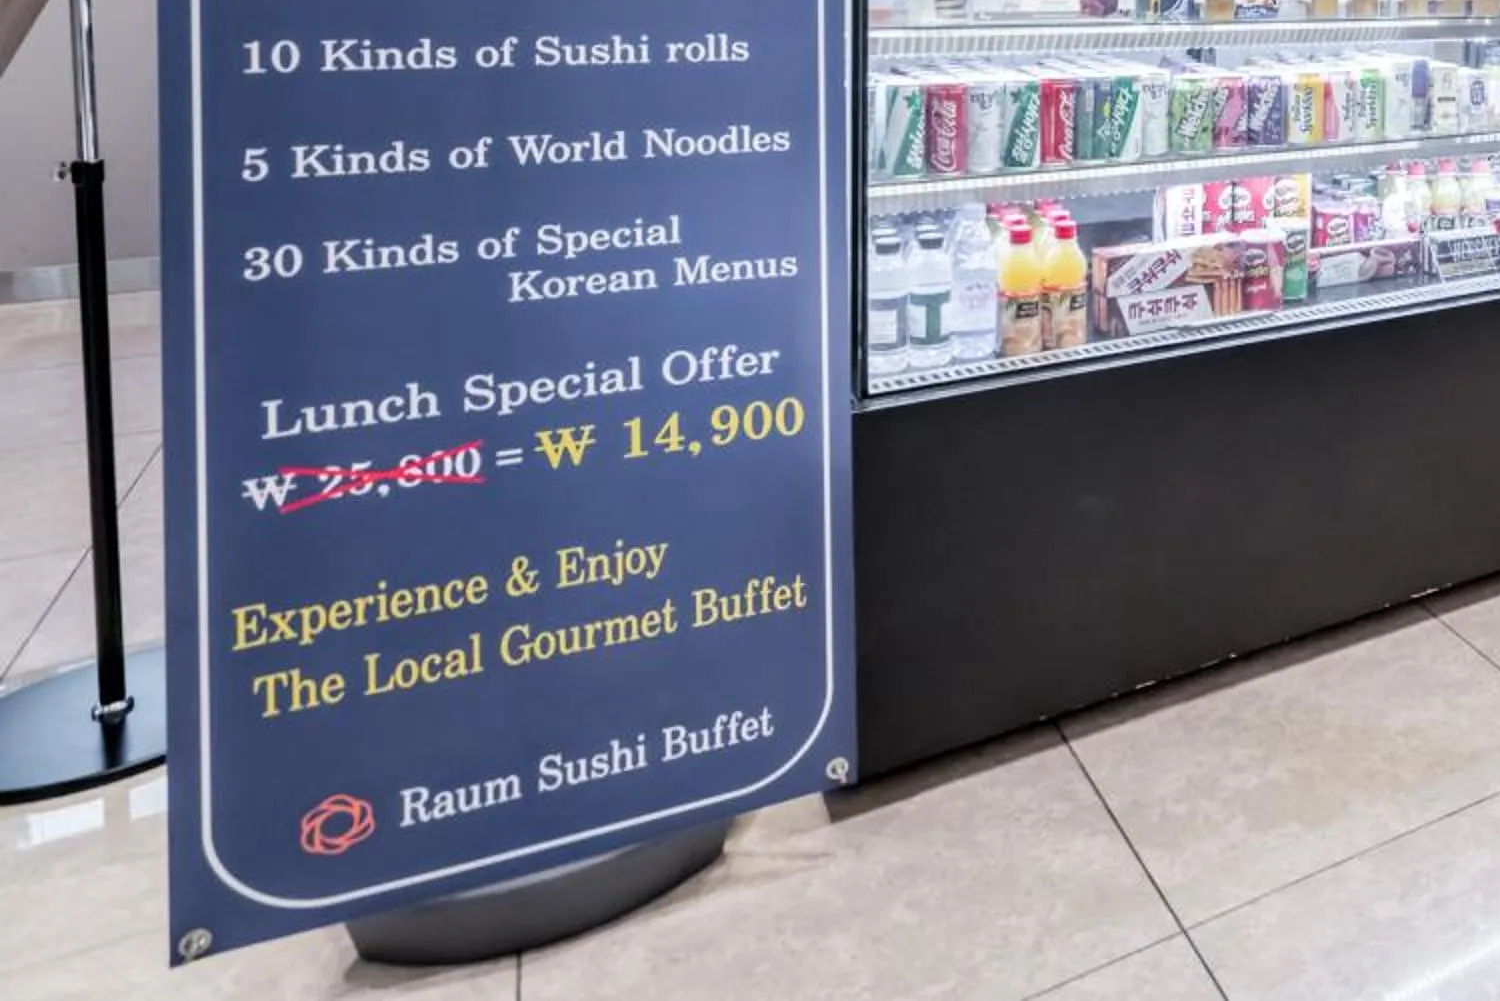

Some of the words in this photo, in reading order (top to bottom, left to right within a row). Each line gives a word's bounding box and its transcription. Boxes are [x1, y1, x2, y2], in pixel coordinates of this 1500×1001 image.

[244, 40, 300, 73] 10
[322, 39, 456, 71] Kinds
[476, 37, 518, 67] of
[536, 35, 649, 65] Sushi
[667, 34, 749, 62] rolls
[242, 148, 268, 181] 5
[292, 141, 430, 177] Kinds
[449, 137, 492, 168] of
[508, 131, 627, 164] World
[644, 125, 790, 157] Noodles
[244, 245, 302, 280] 30
[324, 234, 459, 273] Kinds
[478, 227, 520, 259] of
[537, 215, 681, 259] Special
[510, 269, 657, 301] Korean
[675, 256, 798, 285] Menus
[262, 383, 440, 439] Lunch
[464, 356, 643, 415] Special
[662, 345, 779, 385] Offer
[496, 448, 522, 465] =
[624, 397, 804, 458] 14,900
[232, 575, 488, 652] Experience
[506, 556, 539, 596] &
[557, 540, 668, 588] Enjoy
[254, 669, 344, 717] The
[365, 633, 483, 695] Local
[501, 600, 677, 665] Gourmet
[692, 575, 806, 627] Buffet
[400, 775, 521, 826] Raum
[539, 734, 647, 791] Sushi
[662, 707, 774, 761] Buffet
